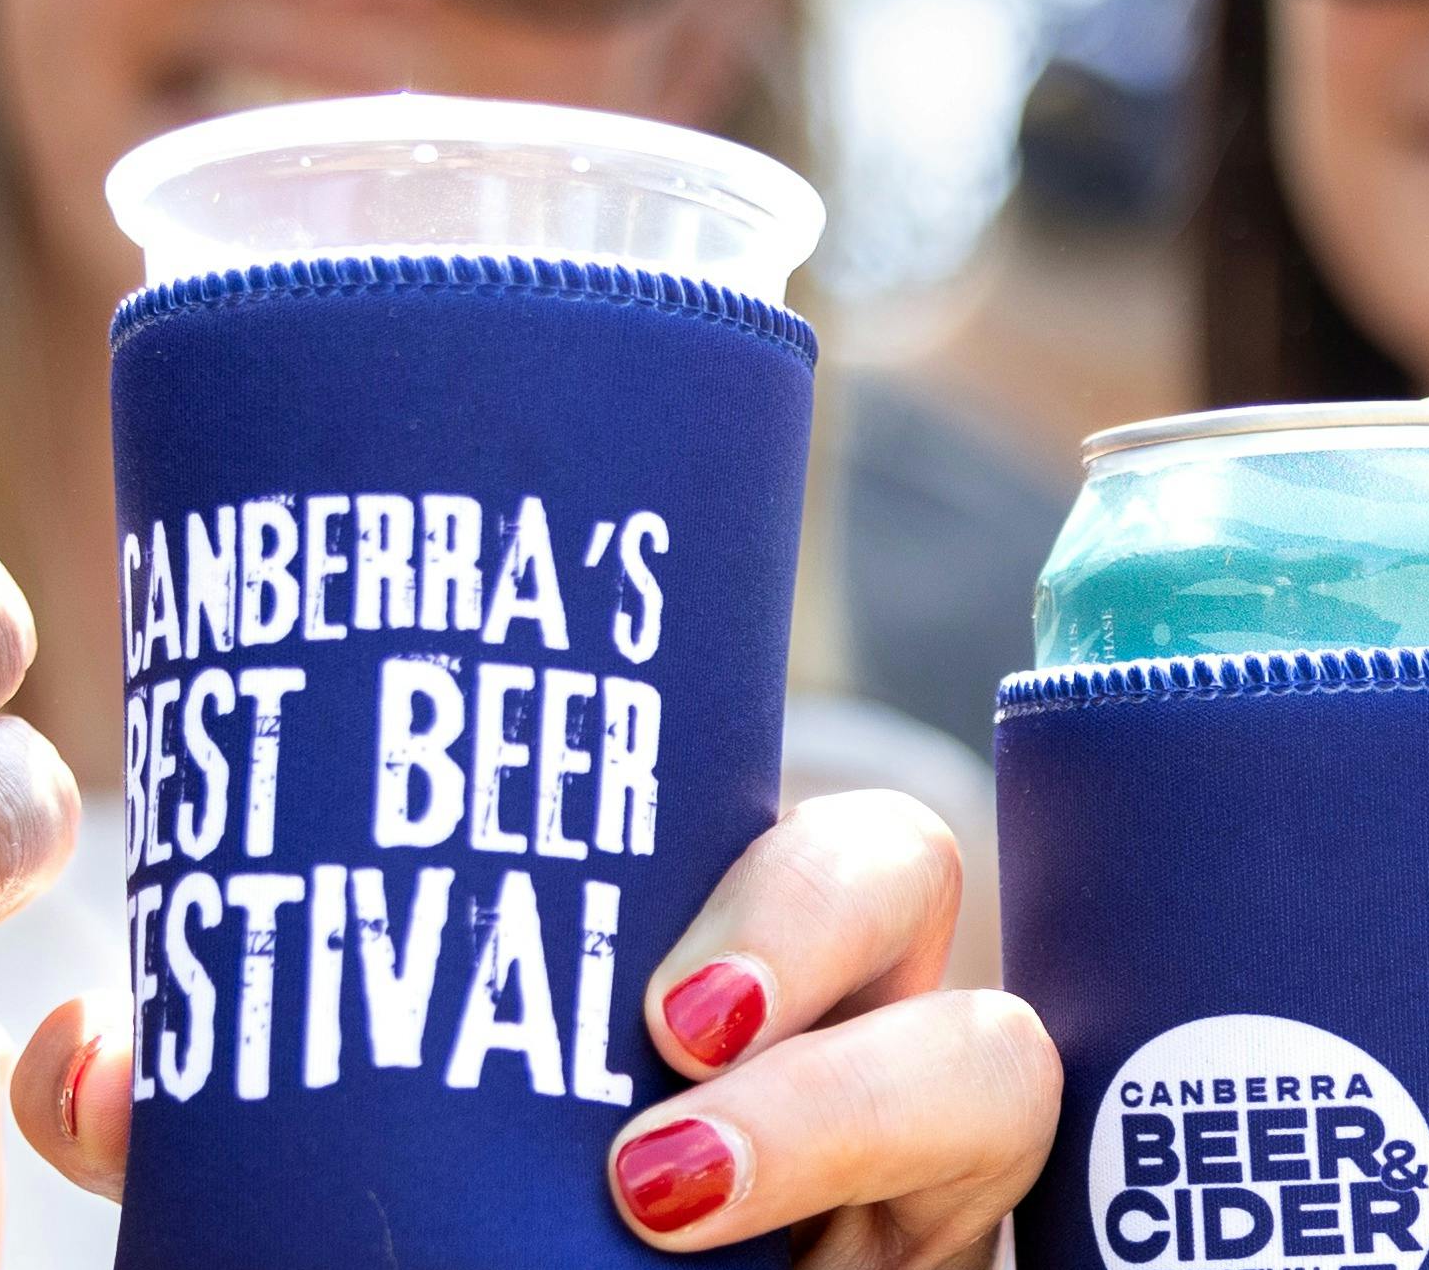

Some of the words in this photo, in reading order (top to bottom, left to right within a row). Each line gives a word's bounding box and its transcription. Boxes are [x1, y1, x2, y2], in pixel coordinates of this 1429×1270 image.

[123, 494, 669, 678] CANBERRA'S
[127, 668, 306, 879] BEST
[373, 656, 661, 860] BEER
[1120, 1073, 1373, 1108] CANBERRA
[1121, 1105, 1386, 1187] BEER
[1106, 1181, 1423, 1264] CIDER
